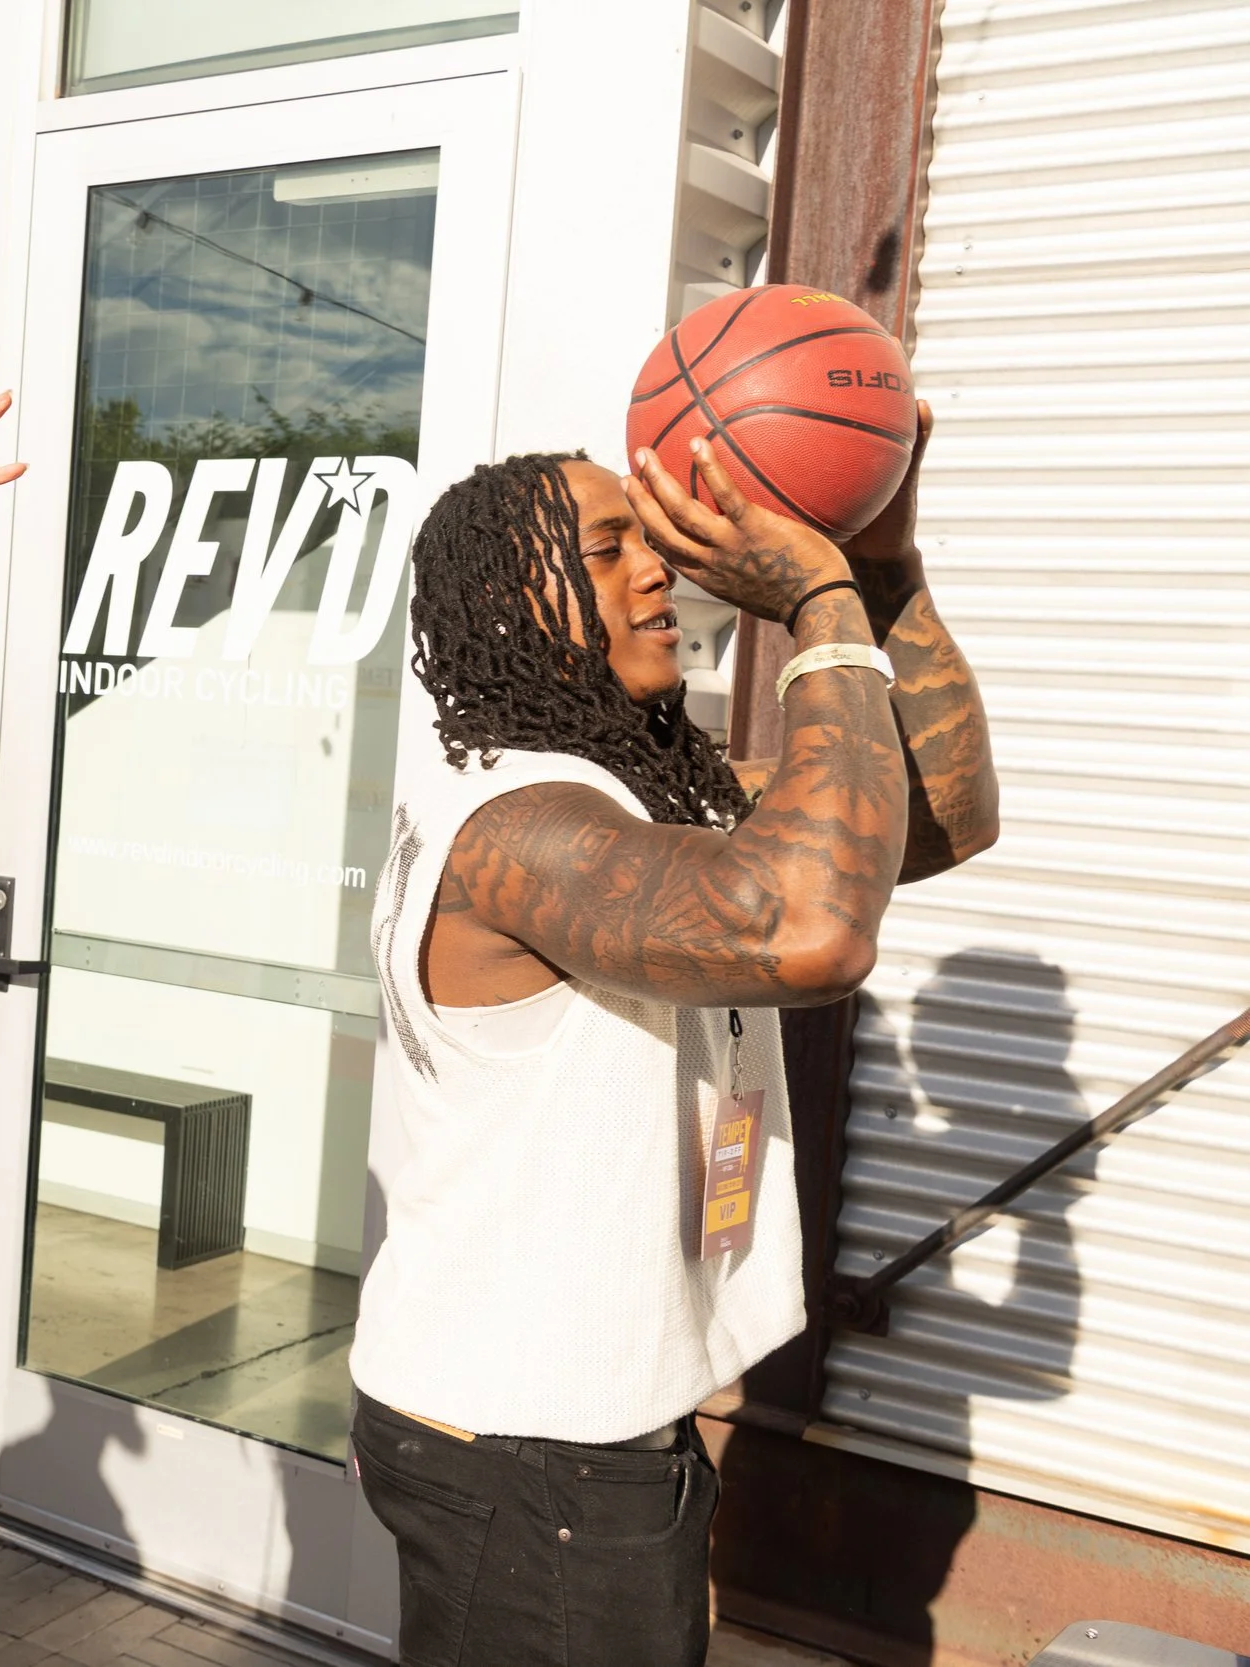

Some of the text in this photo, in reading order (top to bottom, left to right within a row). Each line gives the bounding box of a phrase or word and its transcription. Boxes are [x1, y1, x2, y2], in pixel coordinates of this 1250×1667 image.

[59, 660, 185, 699] INDOOR
[195, 667, 350, 710] CYCLING
[717, 1119, 746, 1148] TEMPE
[719, 1201, 737, 1221] VIP
